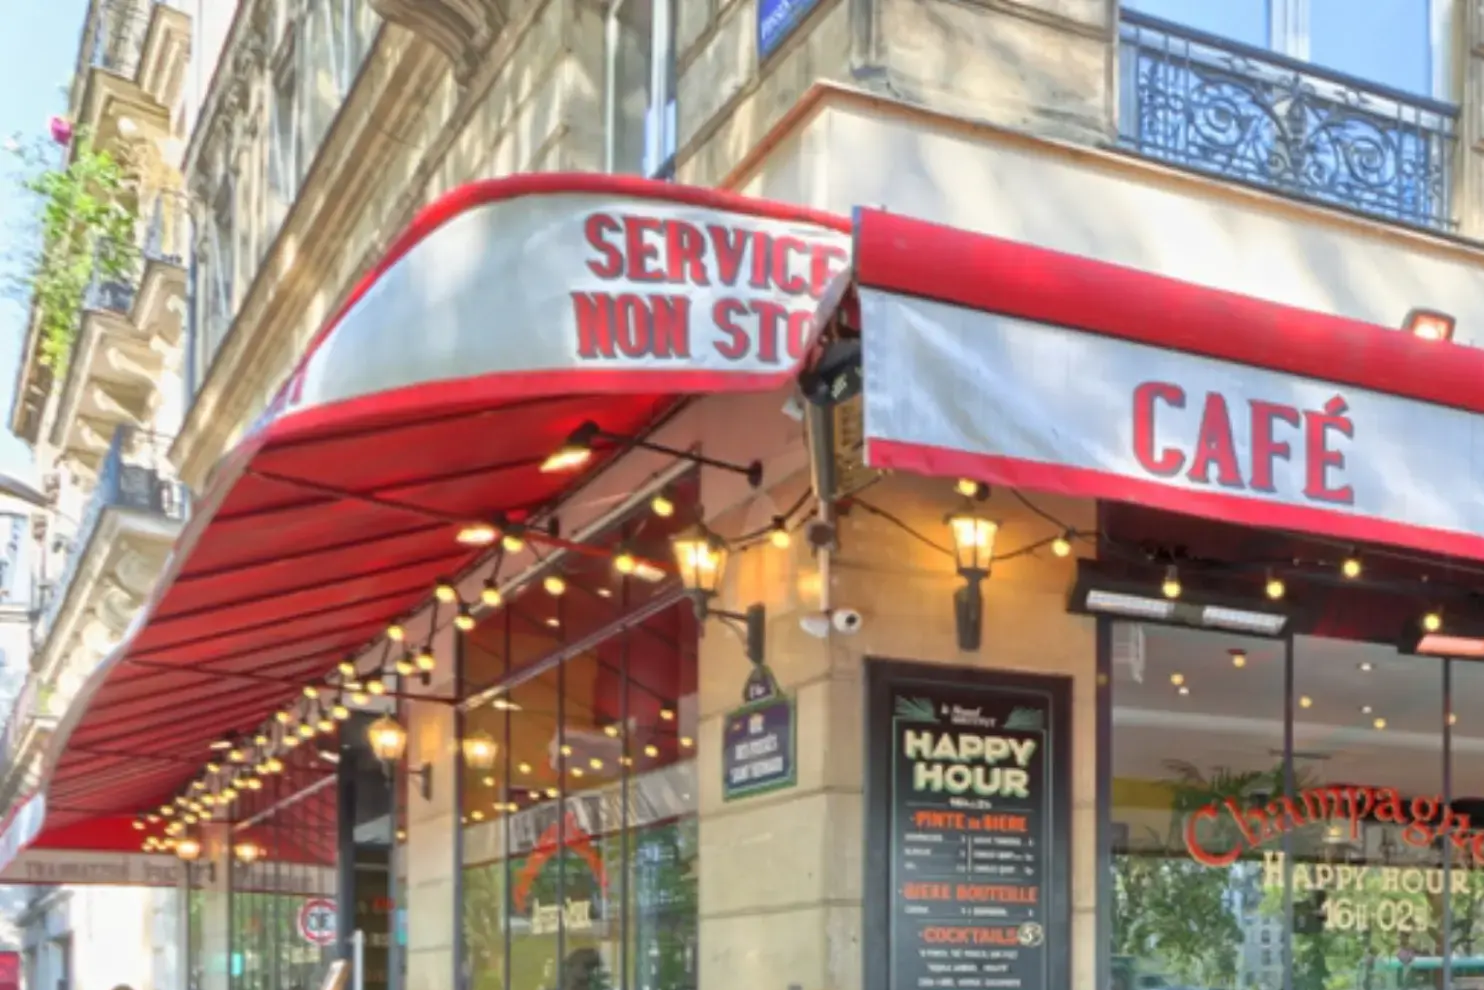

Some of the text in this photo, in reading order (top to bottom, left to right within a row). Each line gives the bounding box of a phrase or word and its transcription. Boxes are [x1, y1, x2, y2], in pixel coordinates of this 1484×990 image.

[569, 291, 691, 359] NON
[1133, 380, 1355, 505] CAFÉ
[904, 730, 1036, 767] HAPPY
[913, 762, 1029, 798] HOUR
[1263, 851, 1470, 895] HAPPY HOUR
